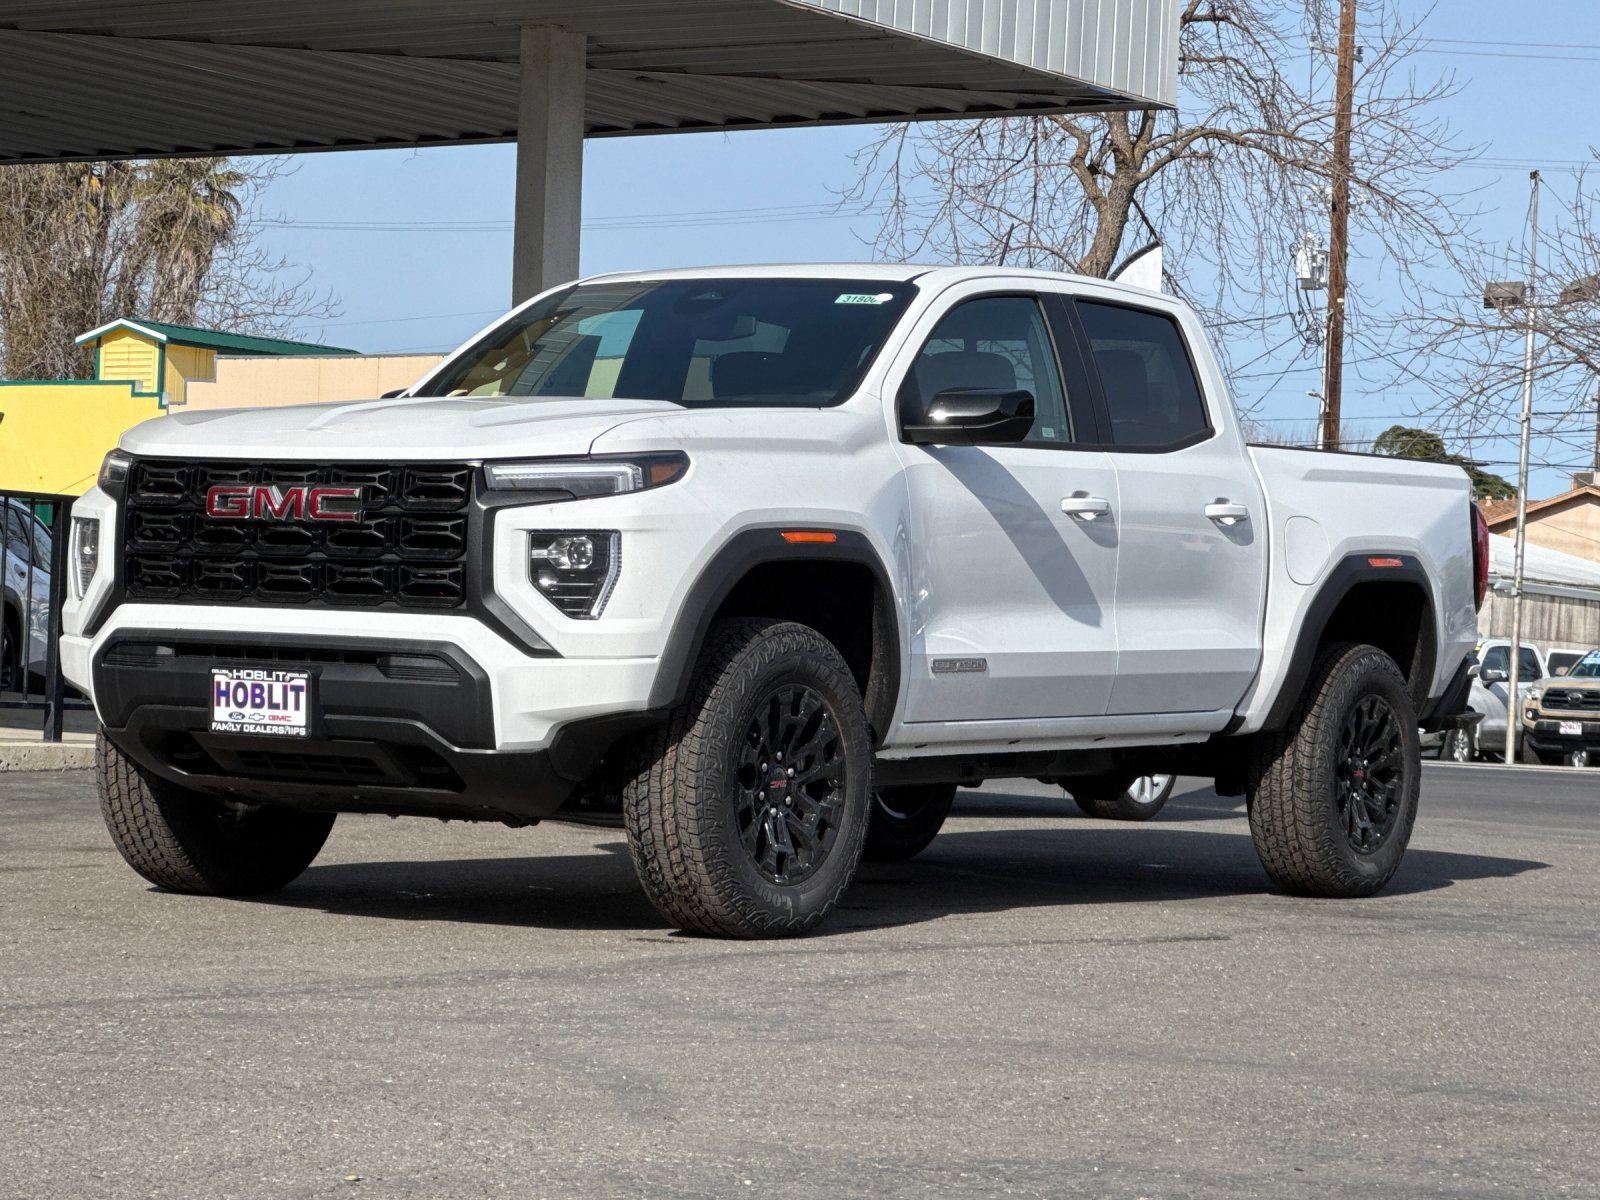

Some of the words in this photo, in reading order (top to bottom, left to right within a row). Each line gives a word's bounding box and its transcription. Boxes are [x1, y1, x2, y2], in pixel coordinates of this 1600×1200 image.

[206, 485, 361, 521] GMC
[233, 669, 286, 681] HOBLIT
[215, 681, 305, 711] HOBLIT
